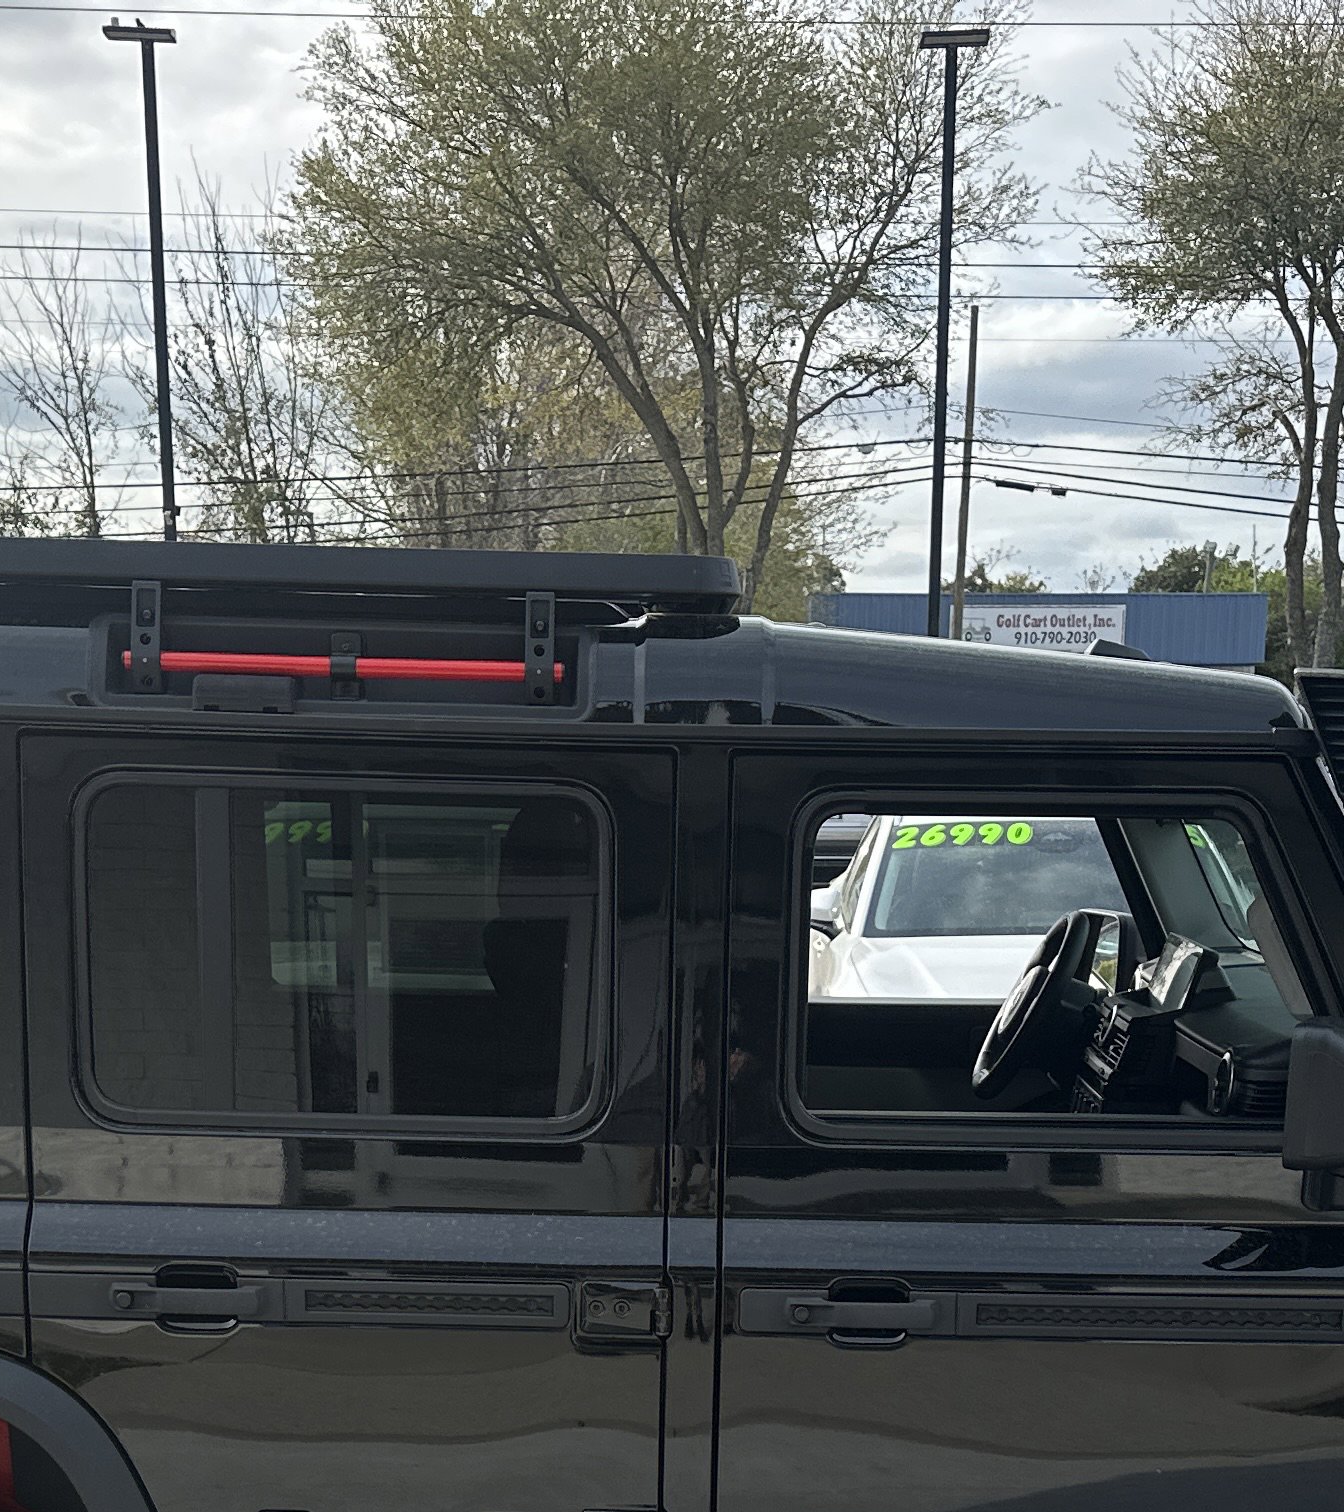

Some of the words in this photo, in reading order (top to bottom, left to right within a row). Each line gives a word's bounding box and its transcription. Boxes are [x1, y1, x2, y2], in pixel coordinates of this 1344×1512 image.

[997, 614, 1021, 628] Golf
[1024, 614, 1047, 628] Cart
[1050, 614, 1091, 631] Outlet,
[1093, 614, 1116, 628] Inc.
[1014, 630, 1097, 645] 910-790-2030
[891, 822, 1034, 849] 26990
